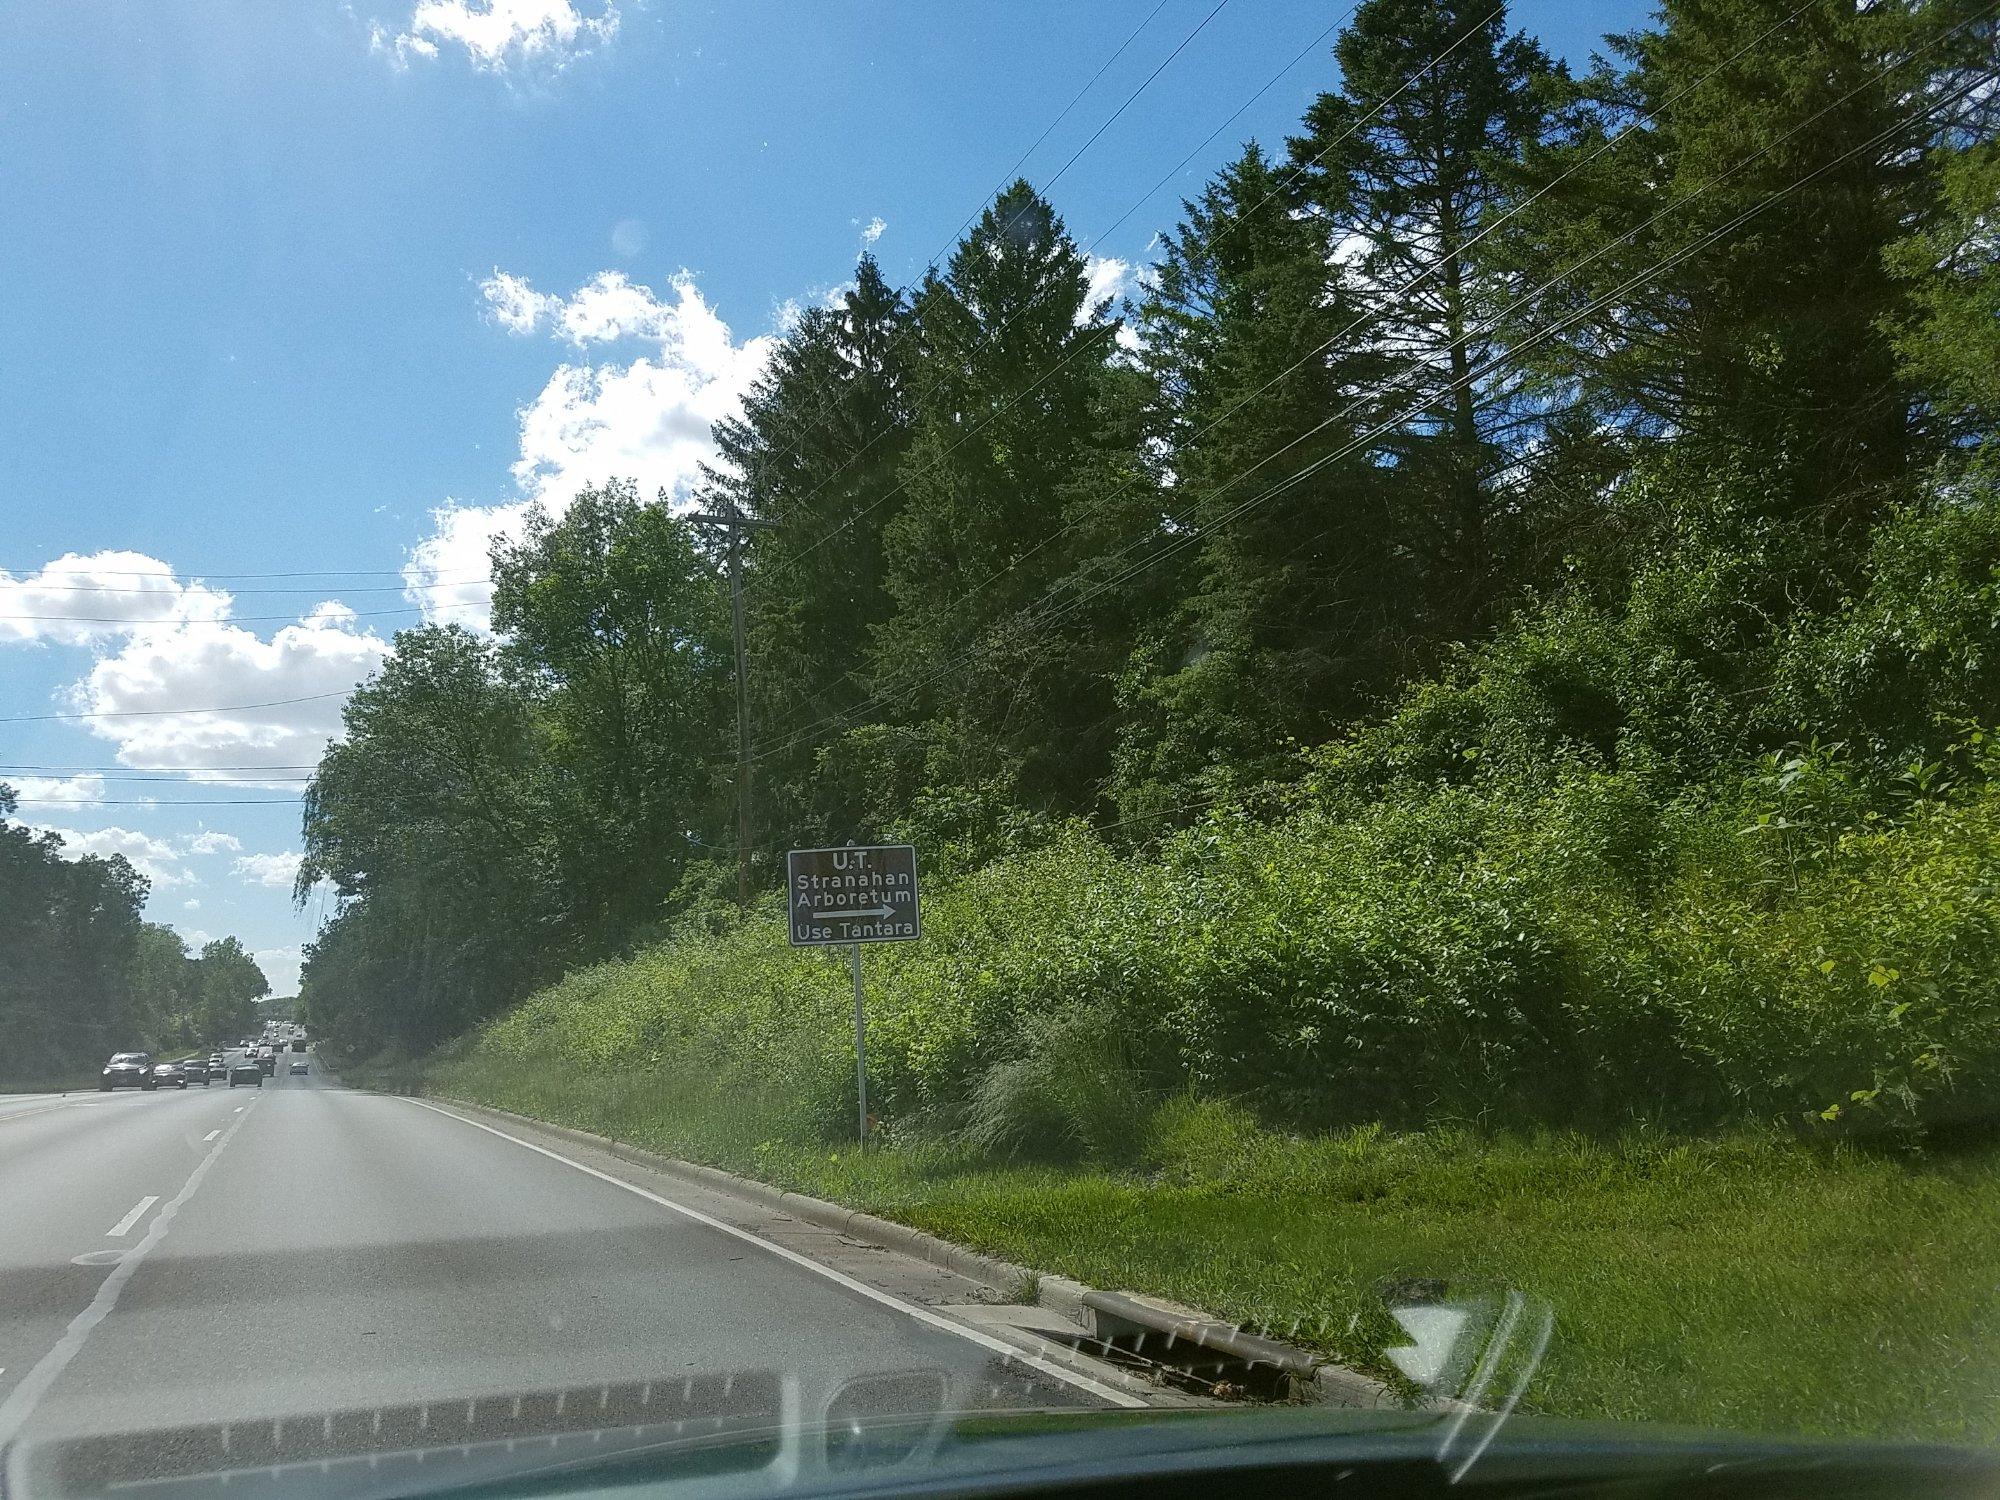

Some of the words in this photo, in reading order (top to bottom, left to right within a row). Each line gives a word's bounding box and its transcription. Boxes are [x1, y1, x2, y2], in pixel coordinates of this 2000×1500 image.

[833, 851, 872, 870] U.T.
[797, 872, 909, 890] Stranahan
[797, 889, 911, 908] Arboretum
[797, 924, 833, 940] Use
[839, 921, 914, 938] Tantara
